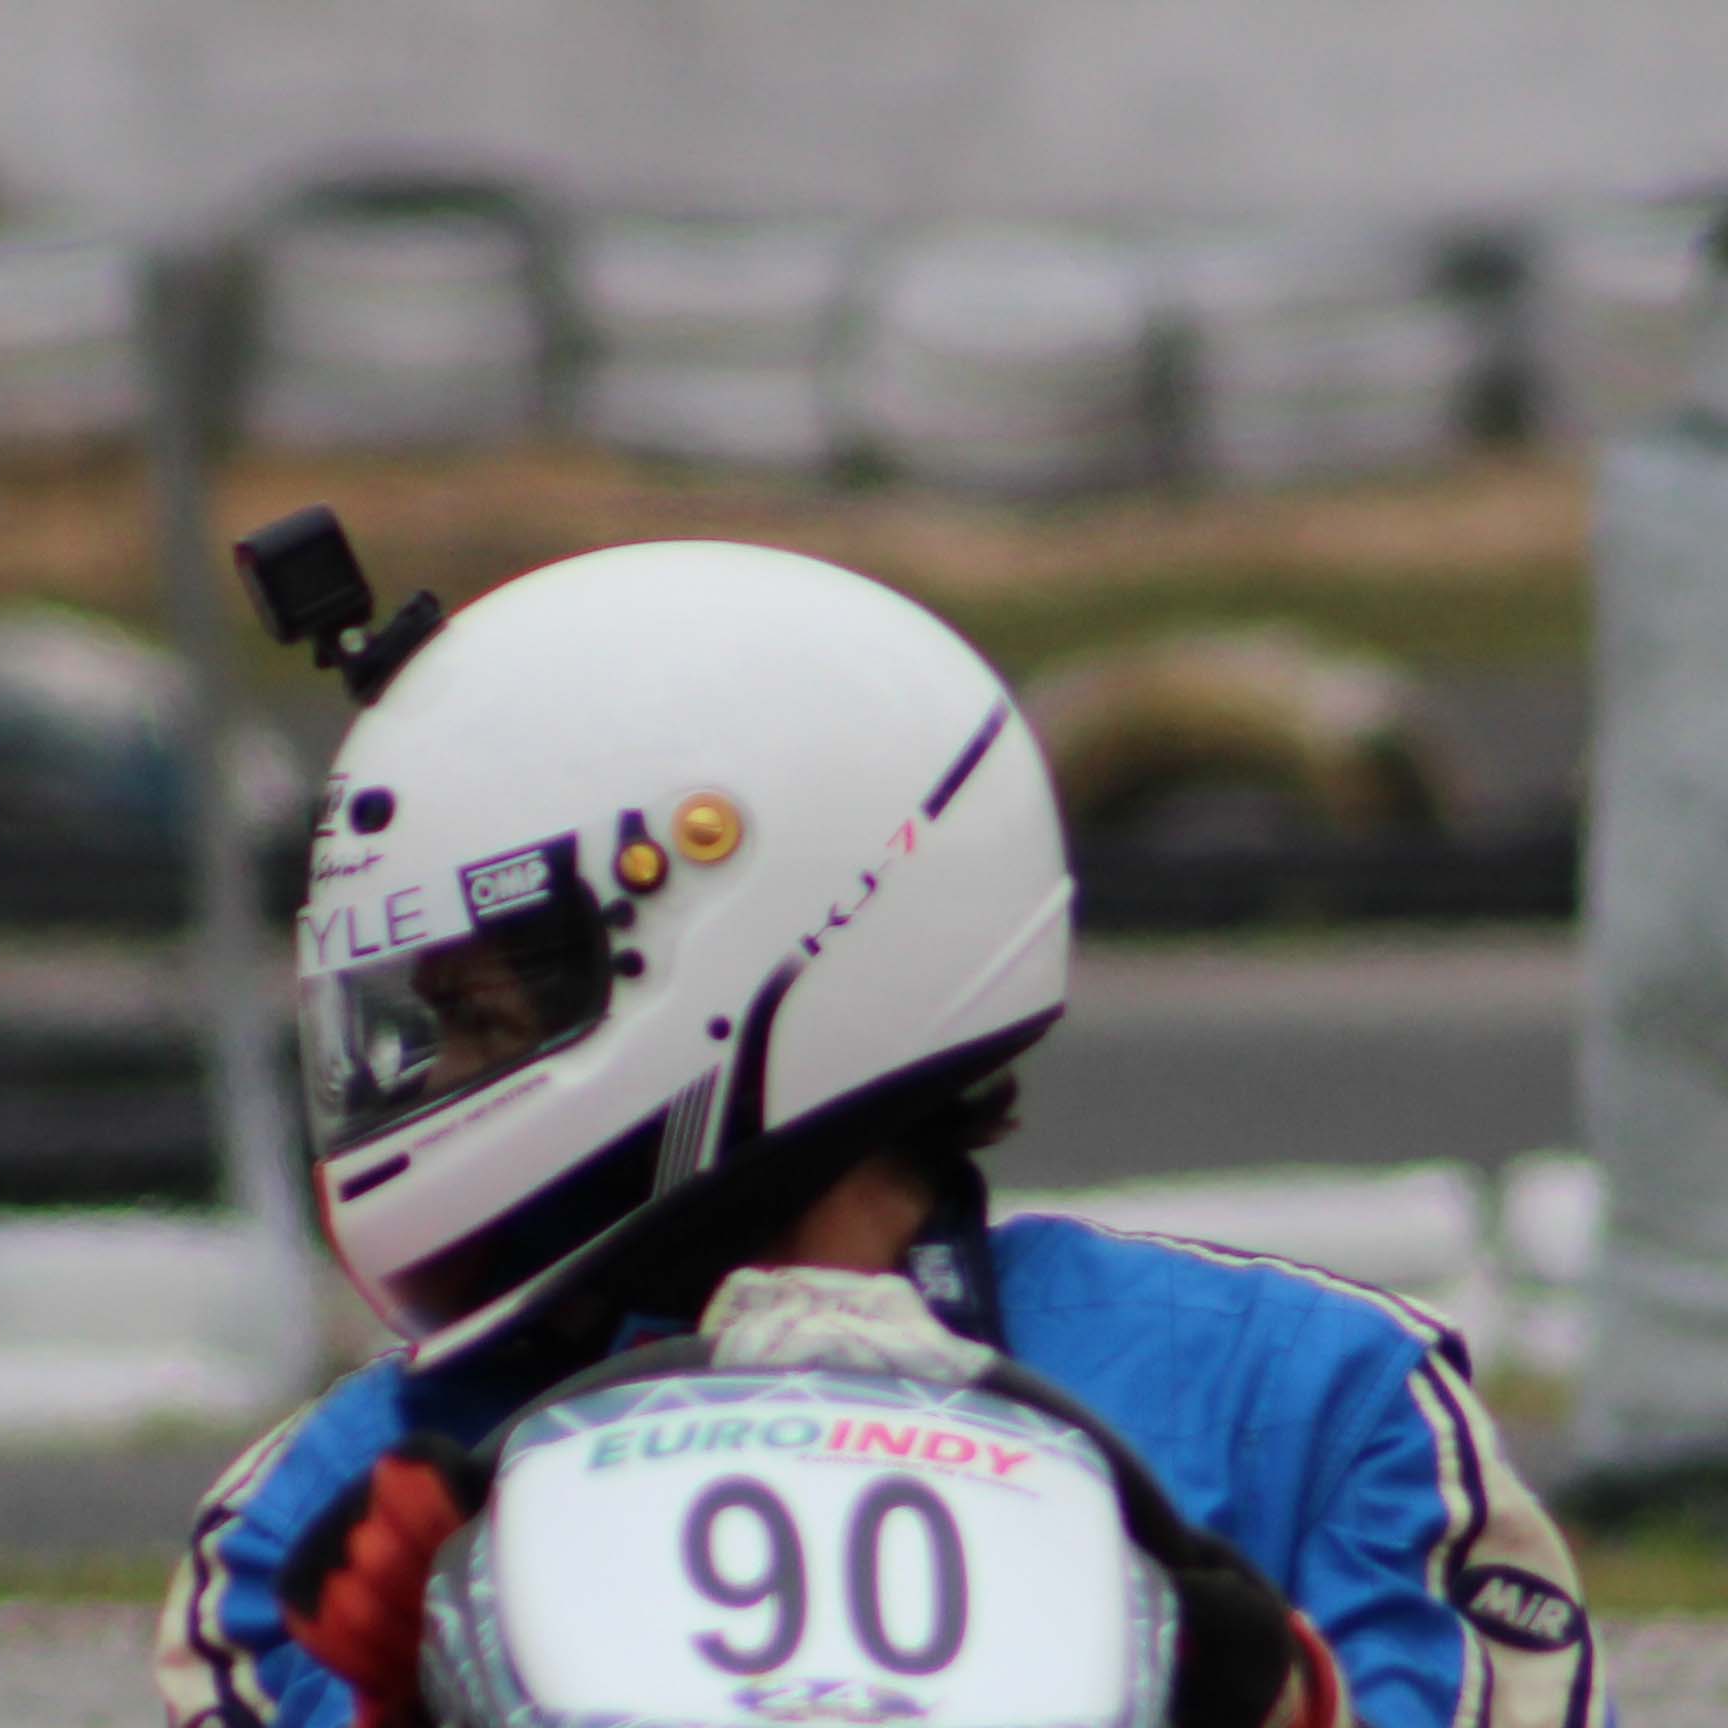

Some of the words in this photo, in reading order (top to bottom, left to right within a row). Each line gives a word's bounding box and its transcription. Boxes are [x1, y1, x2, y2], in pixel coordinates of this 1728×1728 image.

[472, 859, 548, 906] OMP
[586, 1417, 1032, 1477] EUROINDY
[680, 1472, 970, 1678] 90
